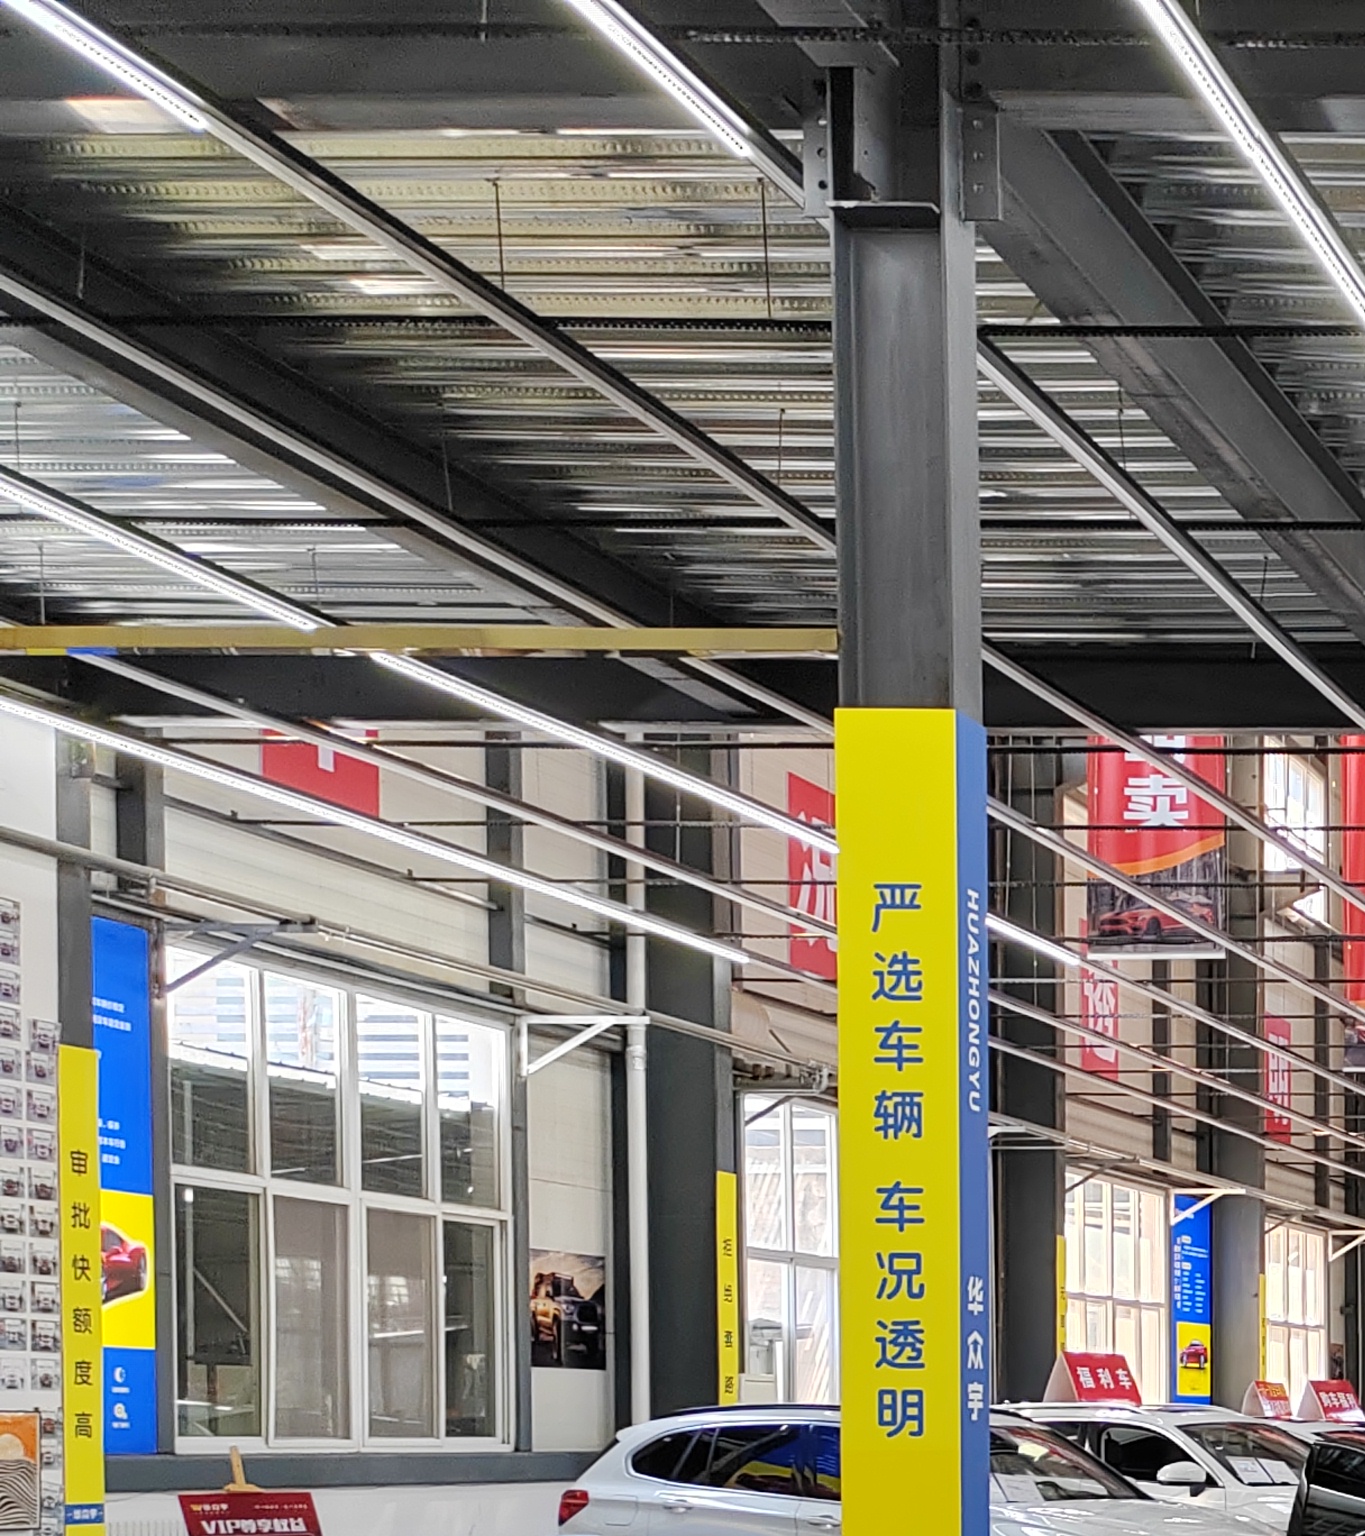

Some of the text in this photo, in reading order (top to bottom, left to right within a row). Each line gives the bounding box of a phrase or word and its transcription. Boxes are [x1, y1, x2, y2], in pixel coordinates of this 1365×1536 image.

[966, 888, 982, 1113] HUAZHONGYU
[871, 883, 926, 1438] 严选车辆 车况透明
[70, 1149, 95, 1440] 审批快额度高
[966, 1275, 985, 1422] 华众宇
[1076, 1366, 1133, 1390] 福利车
